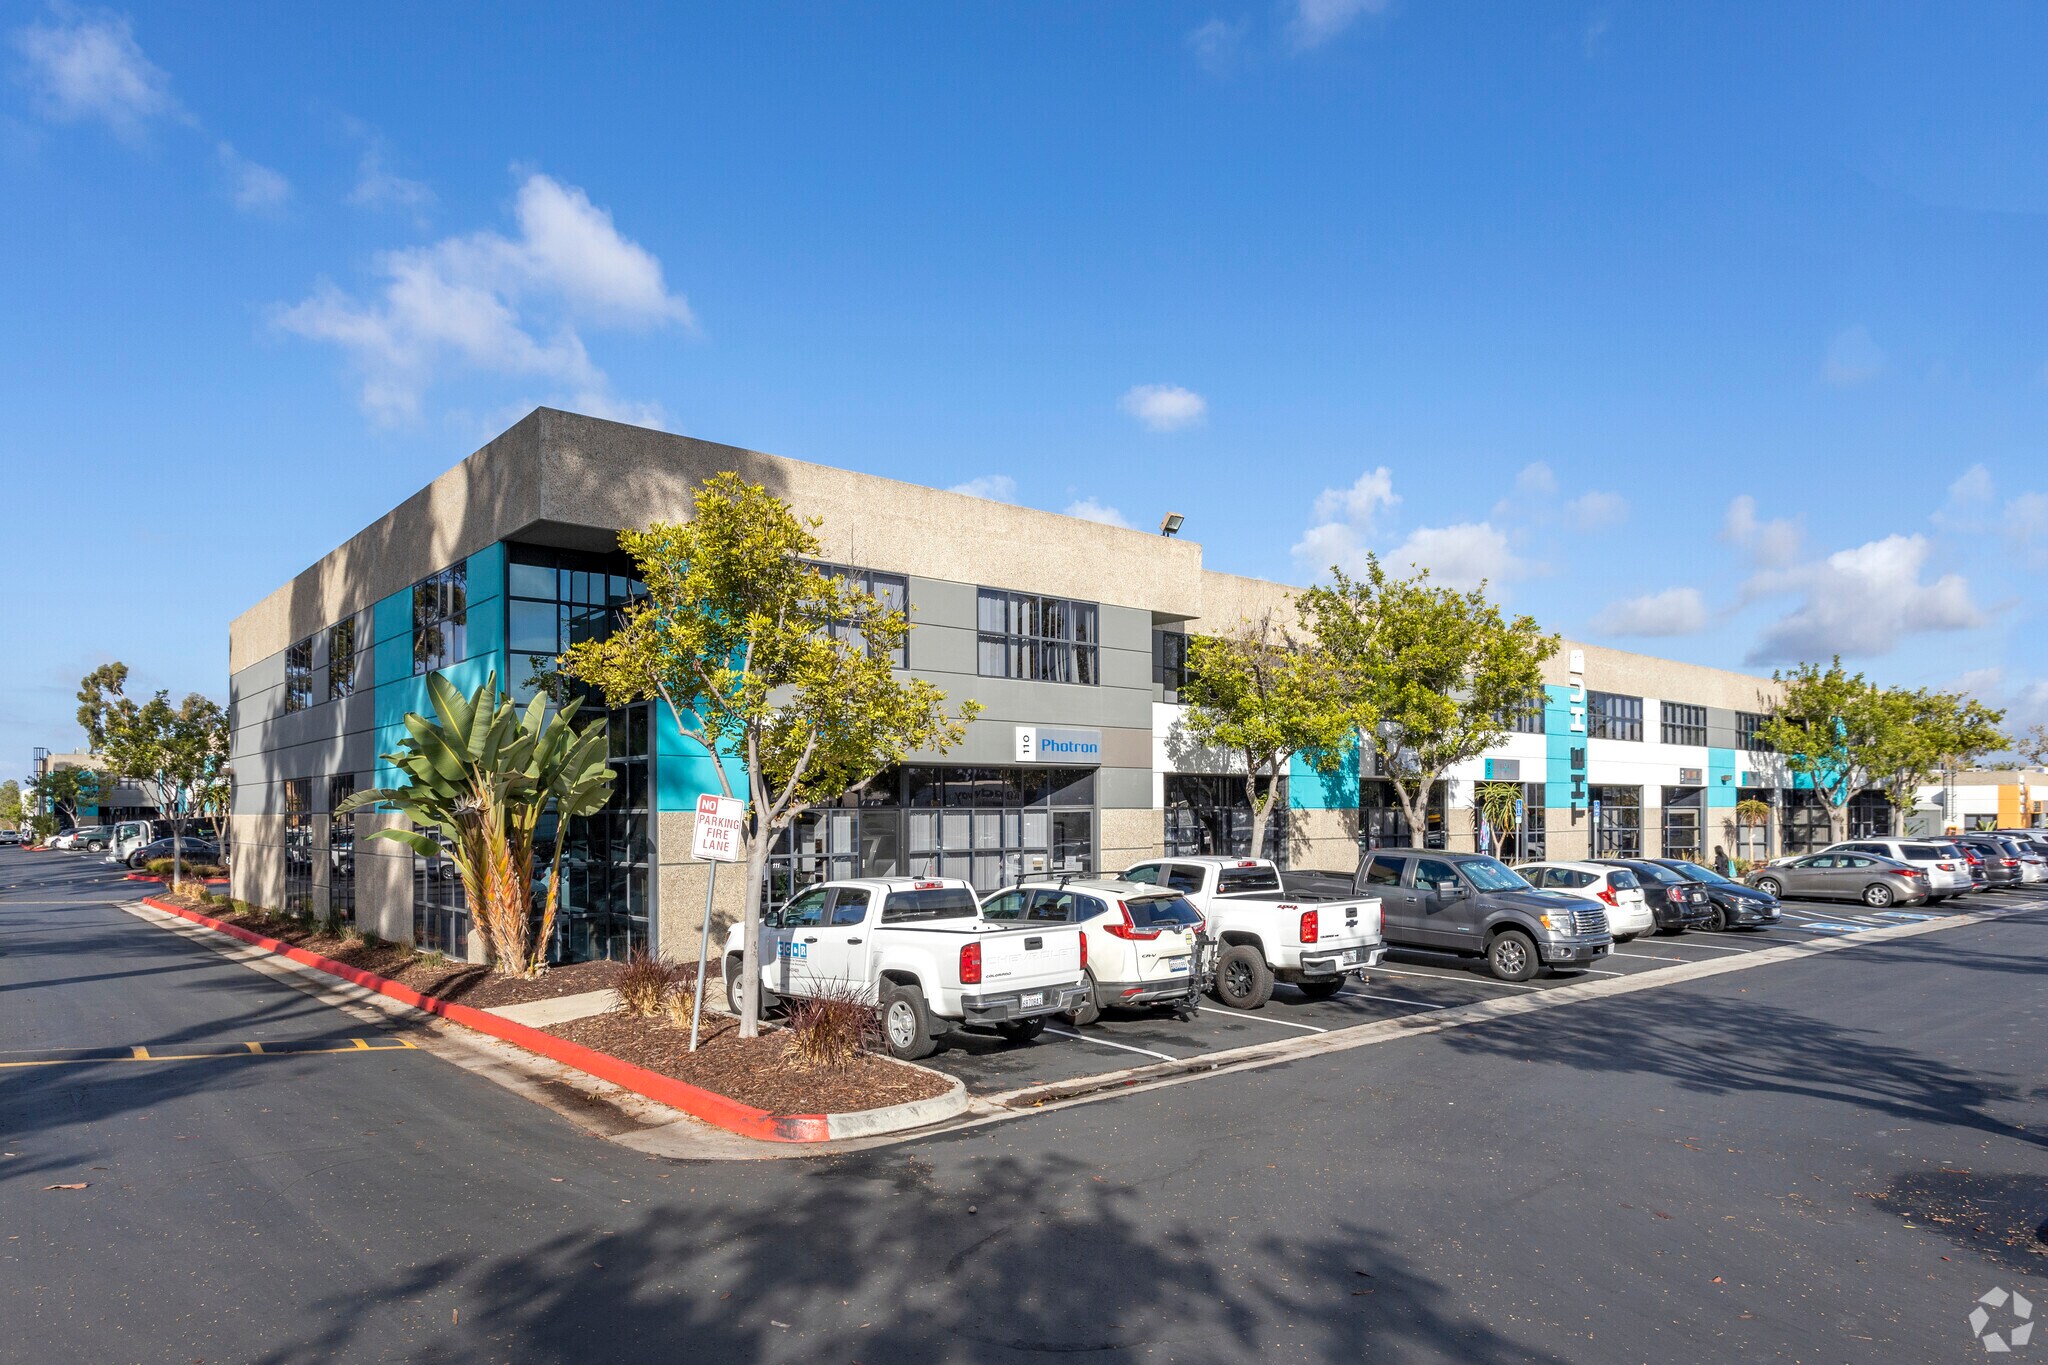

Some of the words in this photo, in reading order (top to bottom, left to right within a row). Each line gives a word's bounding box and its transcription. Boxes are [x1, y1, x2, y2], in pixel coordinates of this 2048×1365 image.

[1569, 649, 1586, 733] HUB
[1022, 734, 1030, 754] 110
[1041, 738, 1098, 753] Photron
[1570, 747, 1586, 827] THE
[701, 799, 717, 811] NO
[699, 814, 740, 830] PARKING
[706, 827, 730, 840] FIRE
[702, 838, 730, 852] LANE
